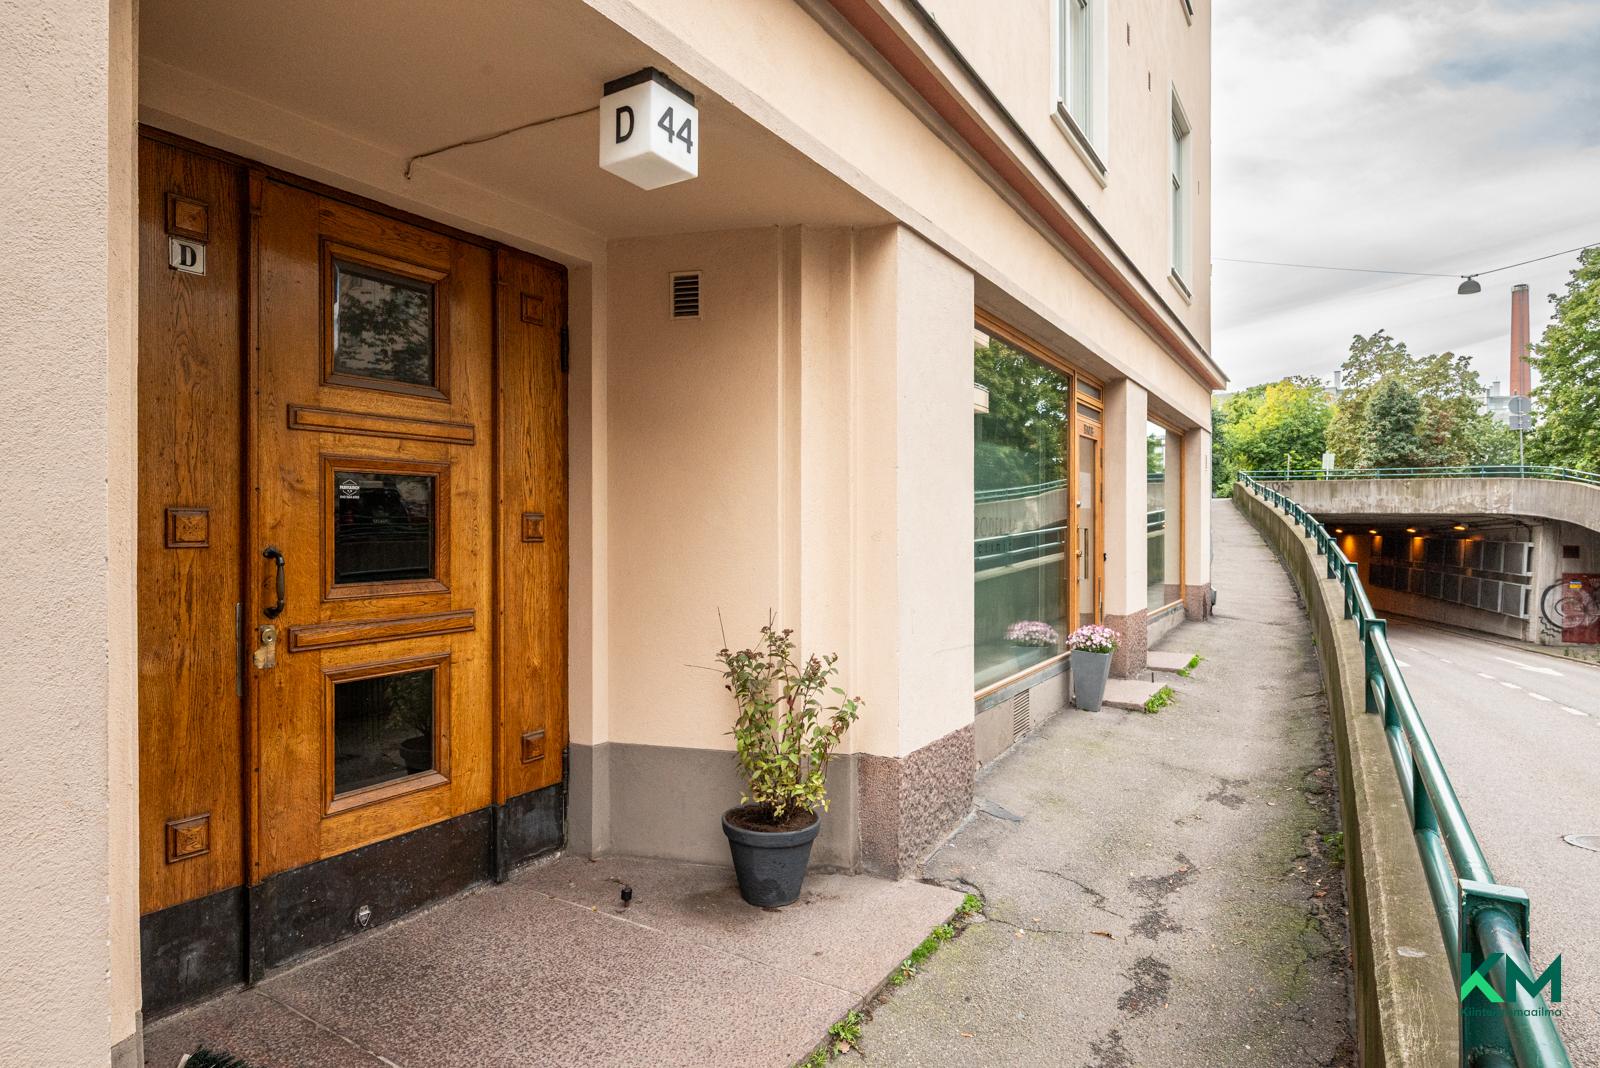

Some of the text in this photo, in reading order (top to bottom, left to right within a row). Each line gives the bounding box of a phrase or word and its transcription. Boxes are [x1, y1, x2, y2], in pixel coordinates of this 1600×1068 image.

[615, 106, 635, 145] D
[657, 106, 694, 155] 44
[178, 243, 197, 267] D
